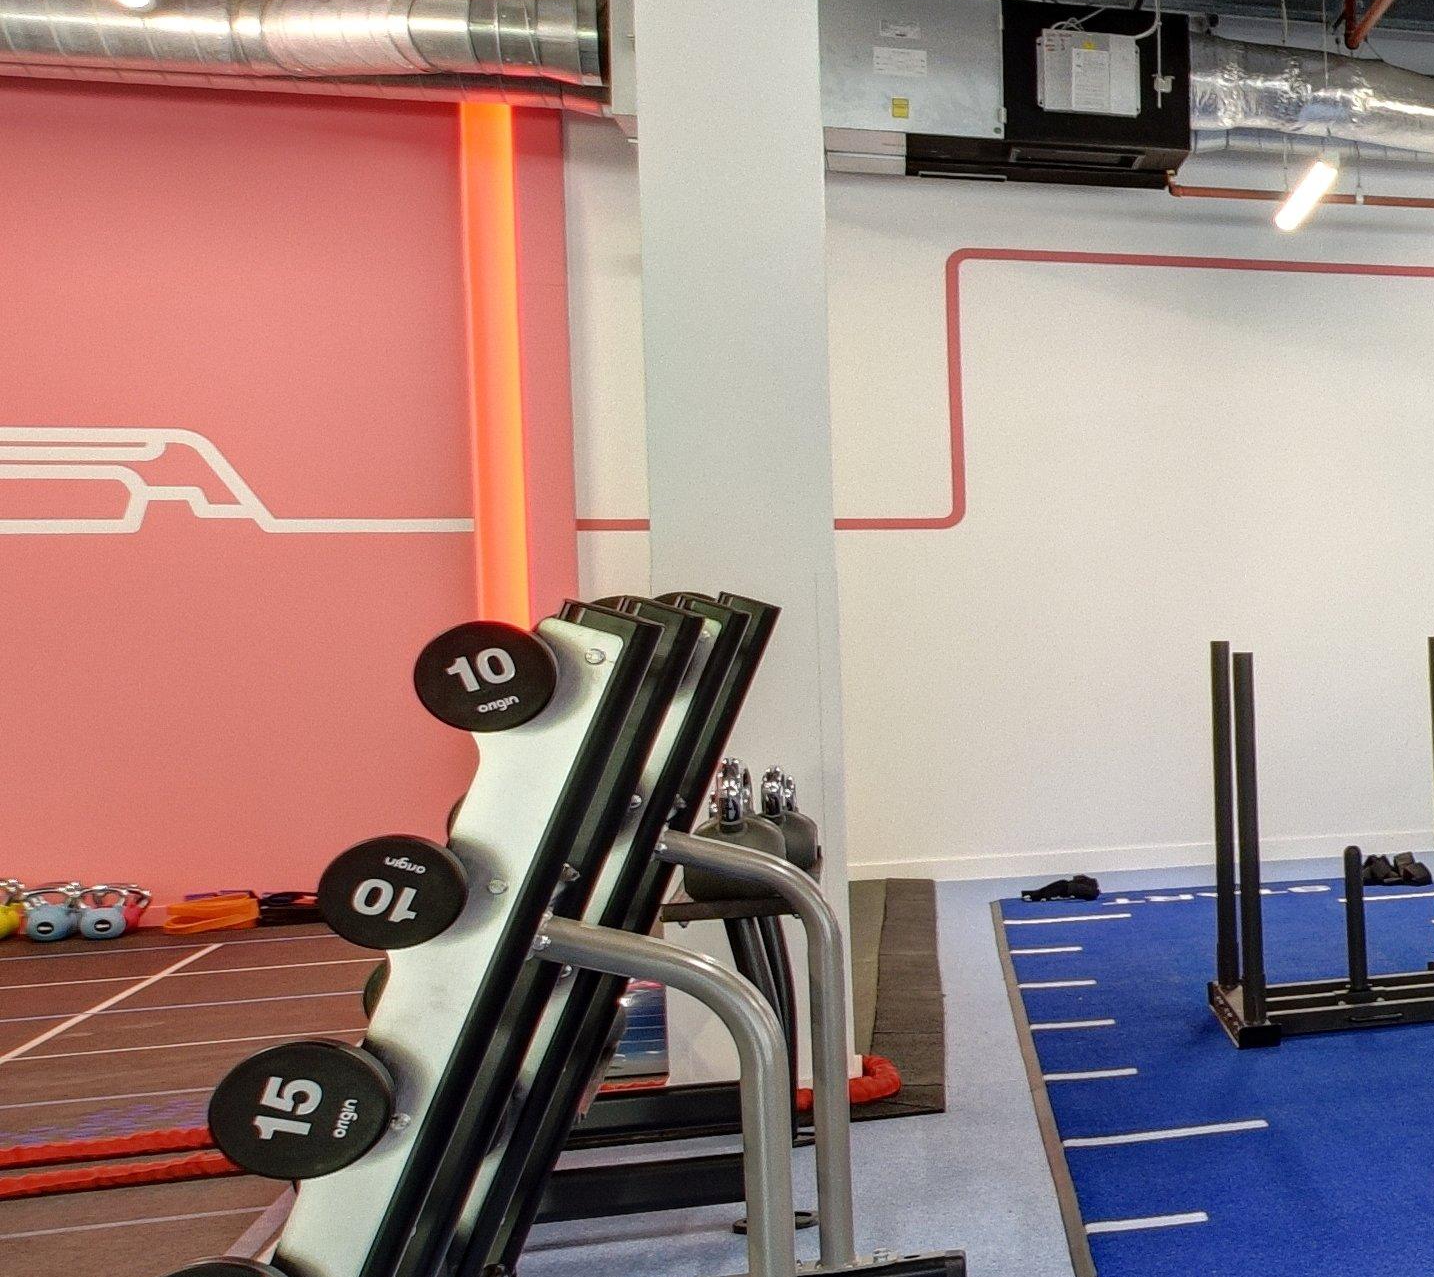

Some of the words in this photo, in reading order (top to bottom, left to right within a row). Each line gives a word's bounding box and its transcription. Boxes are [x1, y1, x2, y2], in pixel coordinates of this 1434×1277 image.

[446, 647, 516, 692] 10
[477, 695, 520, 713] origin
[384, 856, 426, 874] origin
[353, 878, 417, 923] 10
[253, 1076, 323, 1140] 15
[333, 1099, 358, 1138] origin
